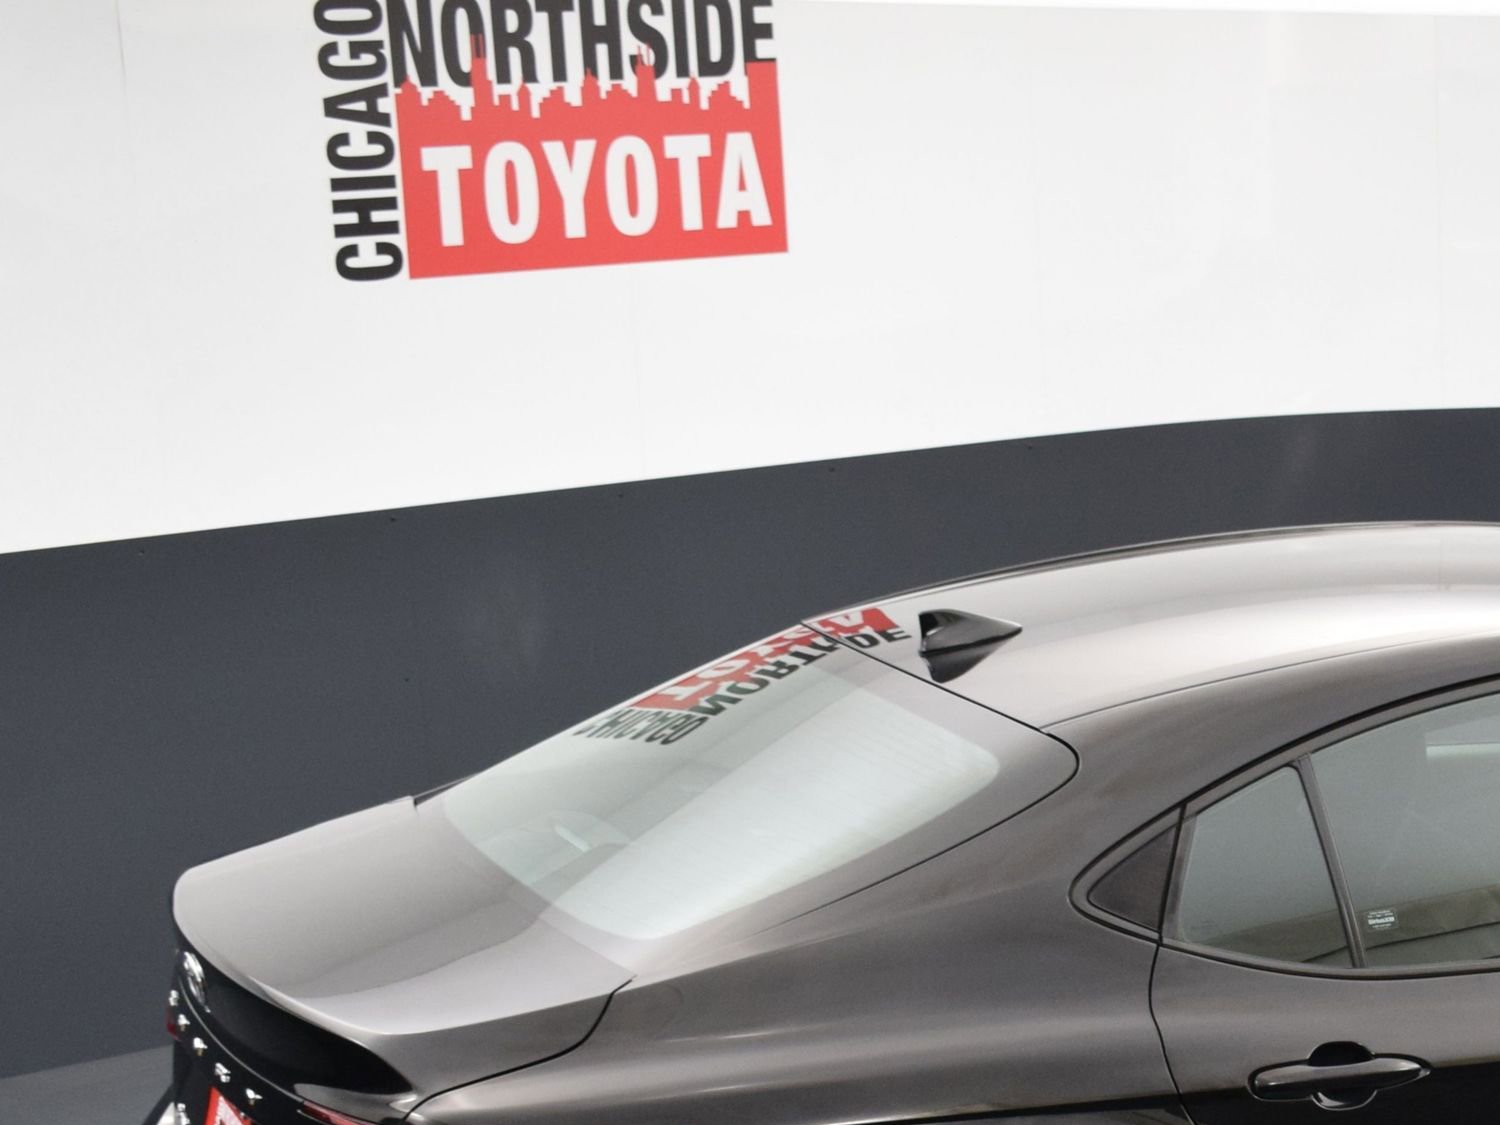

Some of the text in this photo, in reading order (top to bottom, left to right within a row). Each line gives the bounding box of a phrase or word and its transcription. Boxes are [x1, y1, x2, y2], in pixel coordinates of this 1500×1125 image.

[386, 0, 778, 89] NORTHSIDE
[313, 0, 404, 283] CHICAGO
[420, 131, 773, 245] TOYOTA
